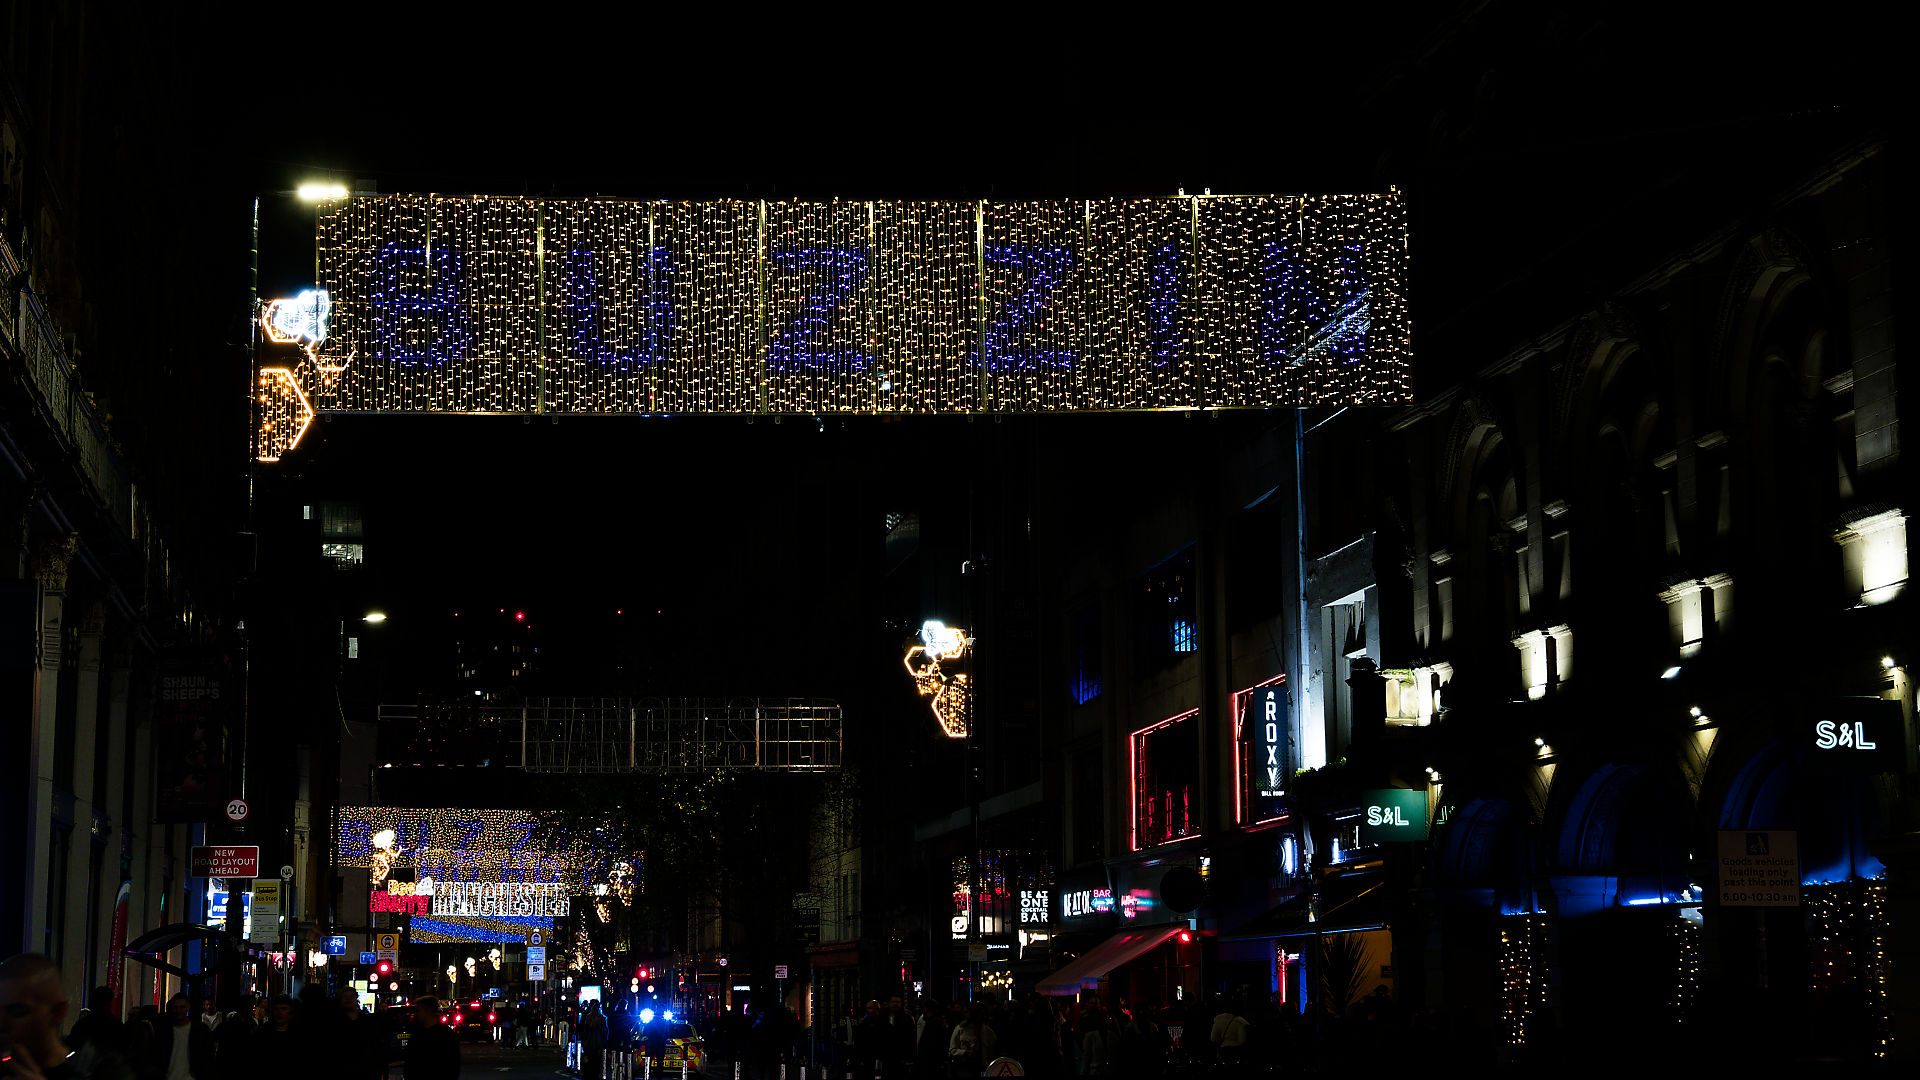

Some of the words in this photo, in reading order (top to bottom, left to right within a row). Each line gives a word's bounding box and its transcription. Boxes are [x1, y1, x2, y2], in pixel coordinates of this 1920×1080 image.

[371, 240, 1371, 371] BUZZIN
[161, 676, 206, 688] SHAUN
[1815, 720, 1876, 750] S&L
[1264, 701, 1278, 788] ROXY
[229, 804, 247, 815] 20
[1367, 806, 1409, 826] S&L
[1722, 857, 1752, 866] Goods
[1756, 857, 1794, 866] vehicles
[1729, 867, 1765, 877] loading
[1767, 867, 1788, 877] only
[1724, 879, 1746, 887] past
[1748, 878, 1767, 887] this
[1769, 878, 1794, 887] point
[432, 881, 570, 917] MANCHESTER
[1020, 890, 1033, 899] BE
[1035, 890, 1048, 899] AT
[1093, 889, 1111, 898] BAR
[1020, 898, 1048, 908] ONE
[1063, 893, 1072, 917] BE
[1073, 891, 1082, 914] AT
[1020, 912, 1048, 923] BAR
